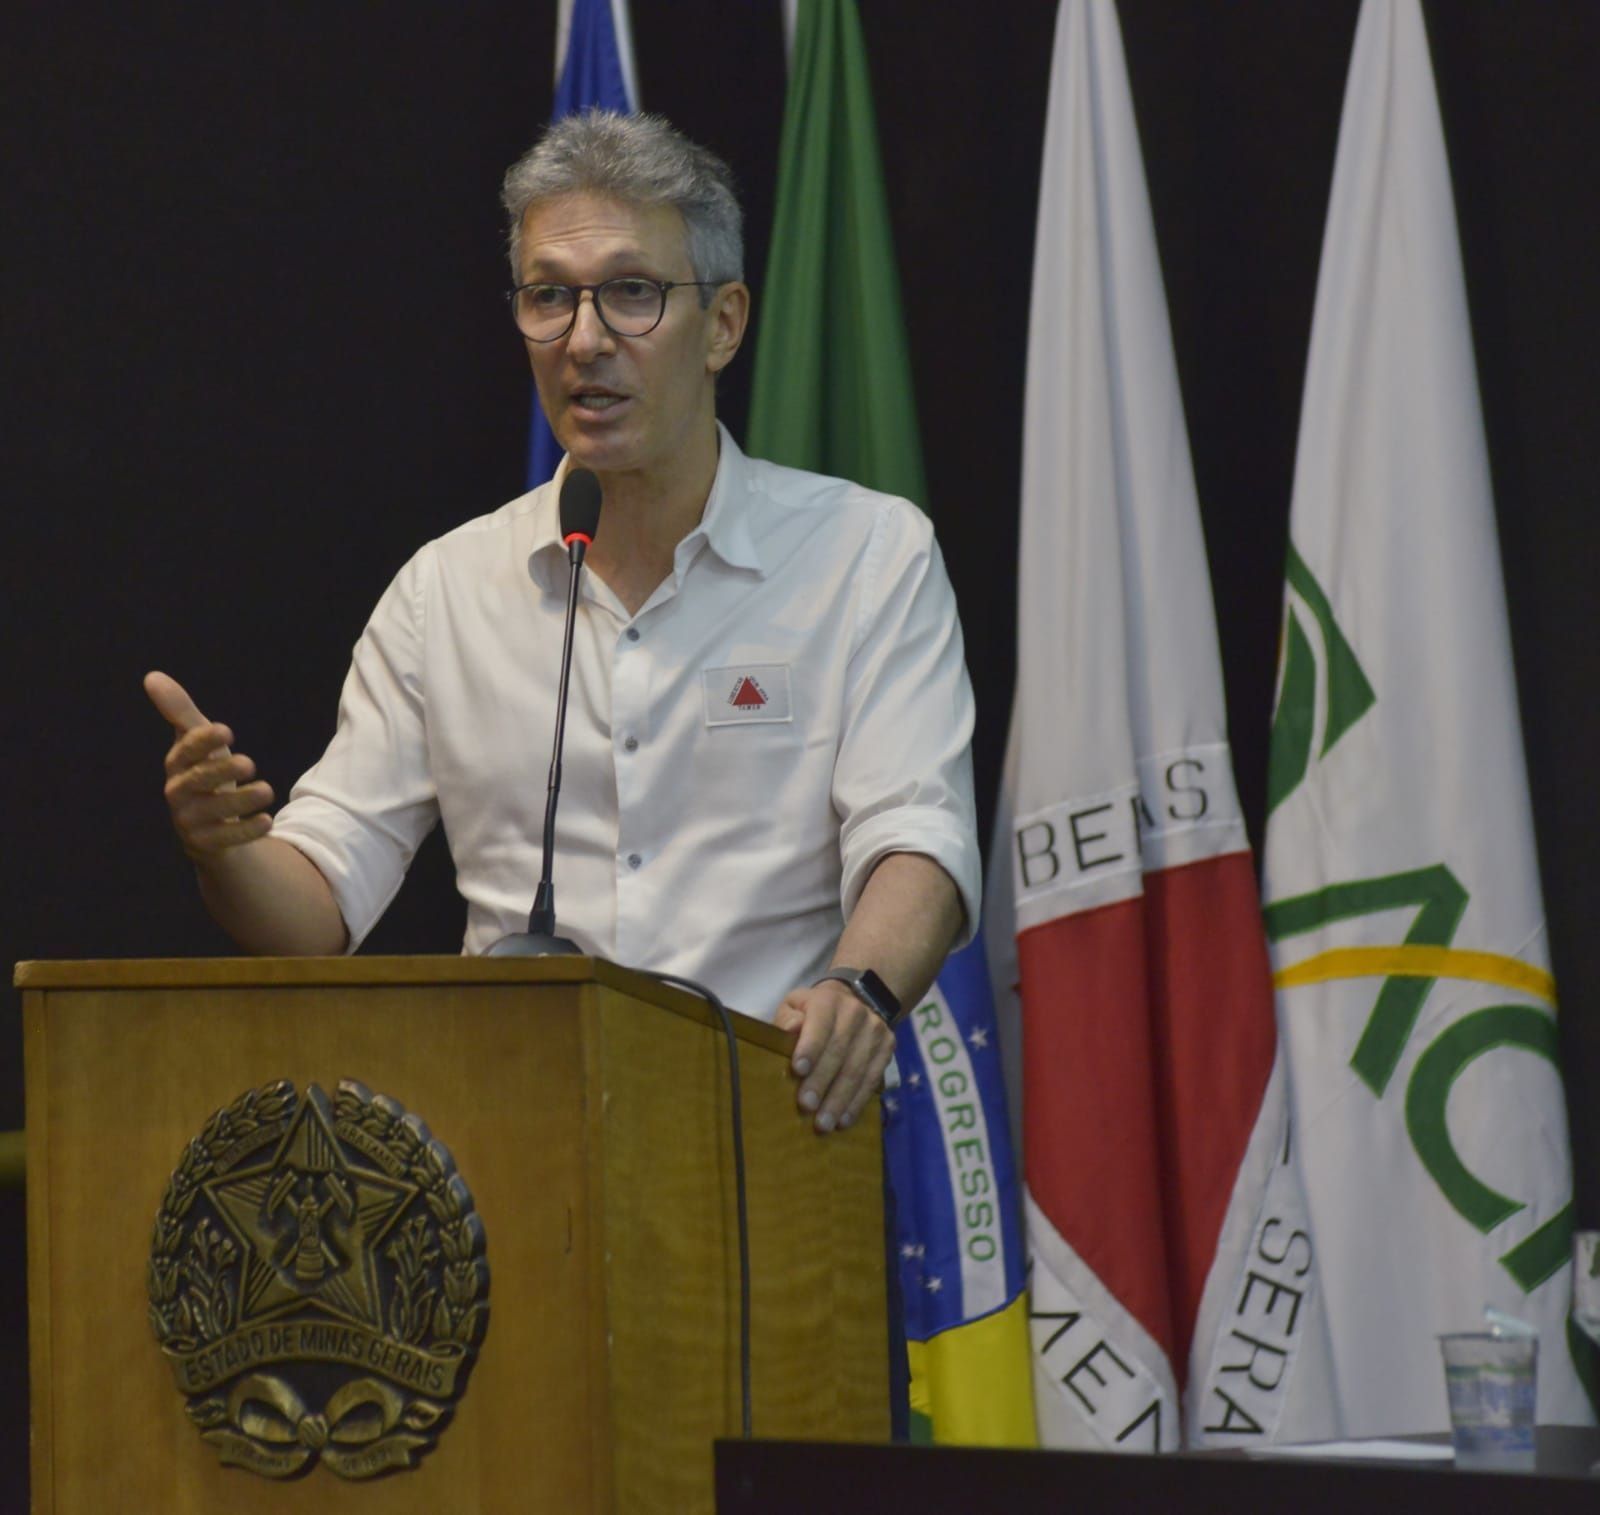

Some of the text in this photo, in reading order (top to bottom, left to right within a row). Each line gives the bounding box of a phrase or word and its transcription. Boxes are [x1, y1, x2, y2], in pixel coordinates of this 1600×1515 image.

[185, 1326, 445, 1391] ESTADO DE MINAS GERAIS
[1203, 1217, 1313, 1435] SERA
